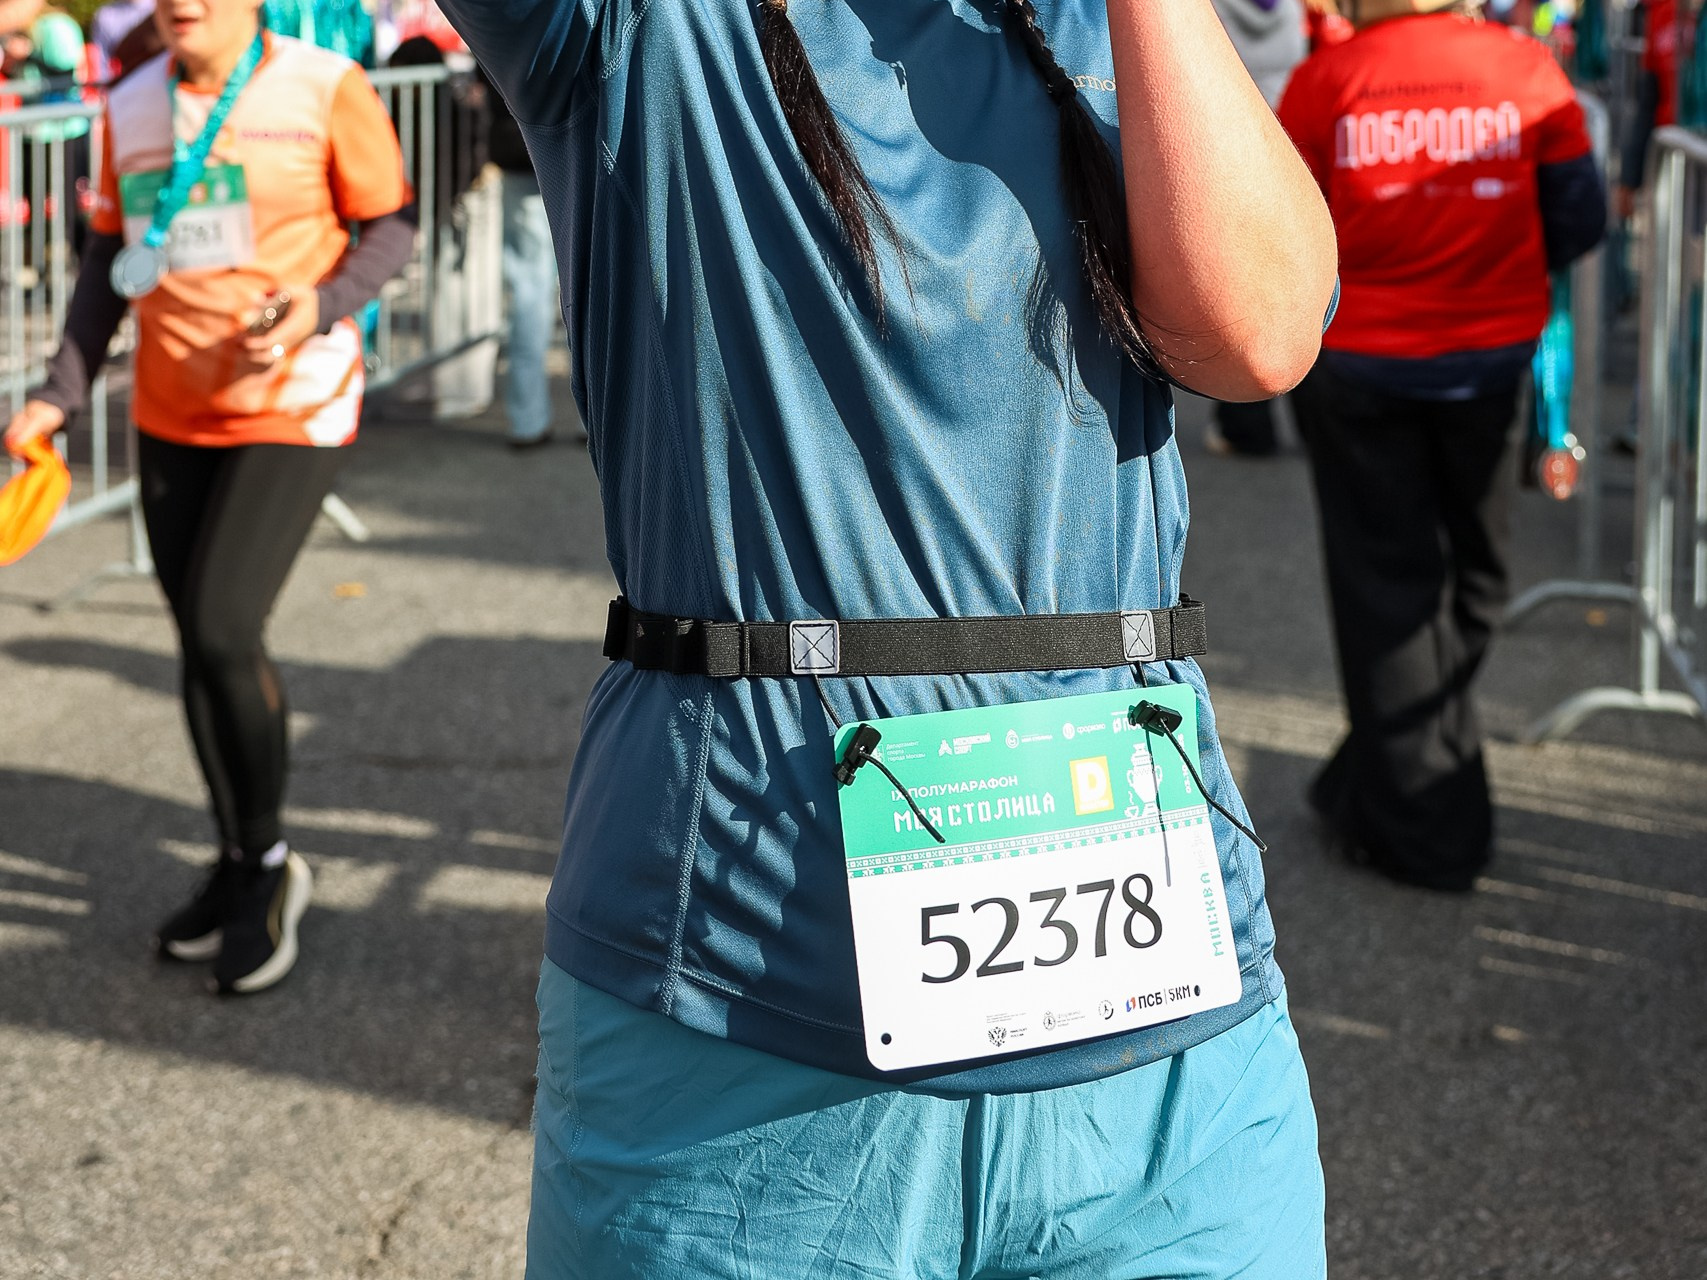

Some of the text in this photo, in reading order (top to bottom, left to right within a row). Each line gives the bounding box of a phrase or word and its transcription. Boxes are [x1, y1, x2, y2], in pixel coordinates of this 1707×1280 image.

[1335, 101, 1522, 170] ДОБРОДЕЙ
[886, 740, 920, 751] Департамент
[909, 774, 1018, 800] ПОЛУМАРАФОН
[947, 792, 1055, 827] СТОЛИЦА
[921, 873, 1162, 984] 52378
[1200, 872, 1225, 956] МОСКВА
[1138, 992, 1163, 1010] ПСБ
